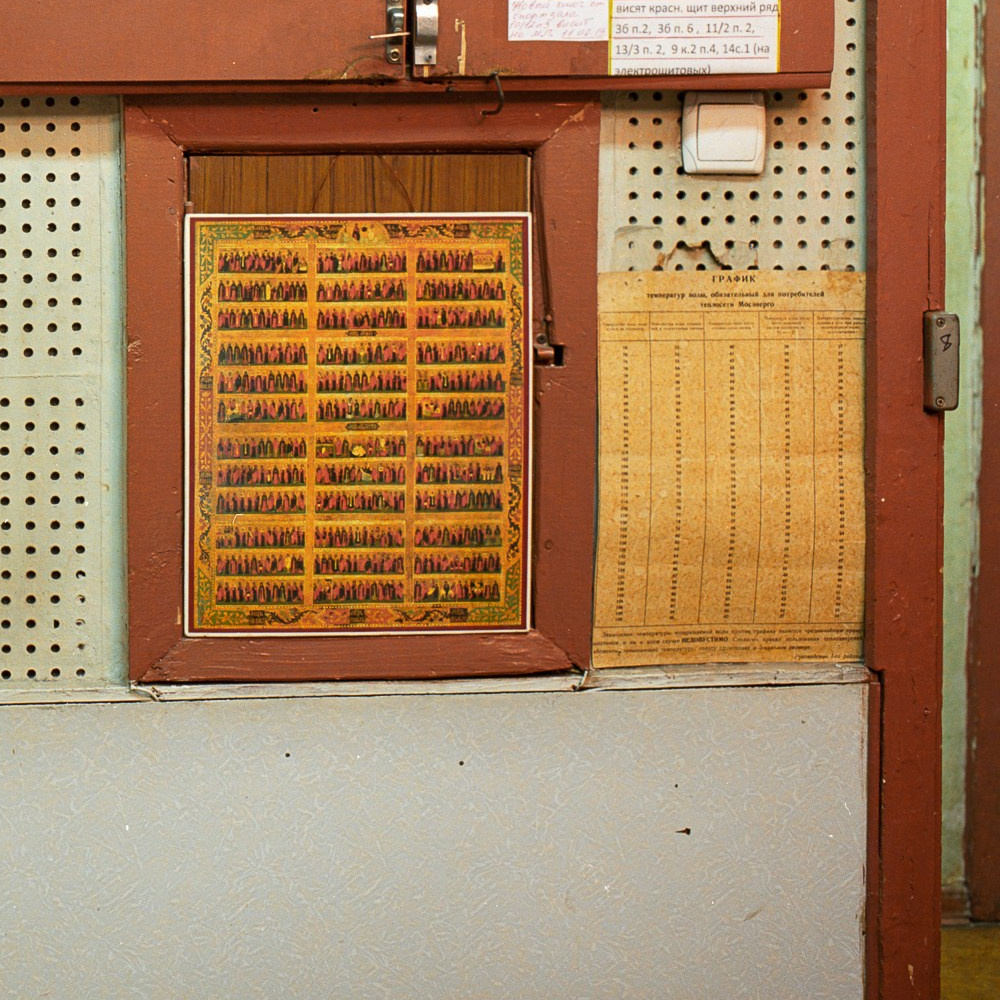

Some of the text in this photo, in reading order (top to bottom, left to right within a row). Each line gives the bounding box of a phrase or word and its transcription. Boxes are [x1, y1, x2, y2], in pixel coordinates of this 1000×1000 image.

[617, 2, 779, 15] висят красн. щит верхний ряд
[706, 22, 729, 34] 11/2
[746, 23, 755, 34] 2,
[616, 44, 639, 56] 13/3
[656, 45, 665, 55] 2,
[672, 44, 677, 54] 9
[682, 44, 696, 54] к.2
[700, 45, 719, 55] п.4,
[724, 44, 749, 53] 14с.1
[754, 44, 770, 55] (на
[712, 275, 756, 283] ГРАФИК
[778, 291, 824, 299] потребителей
